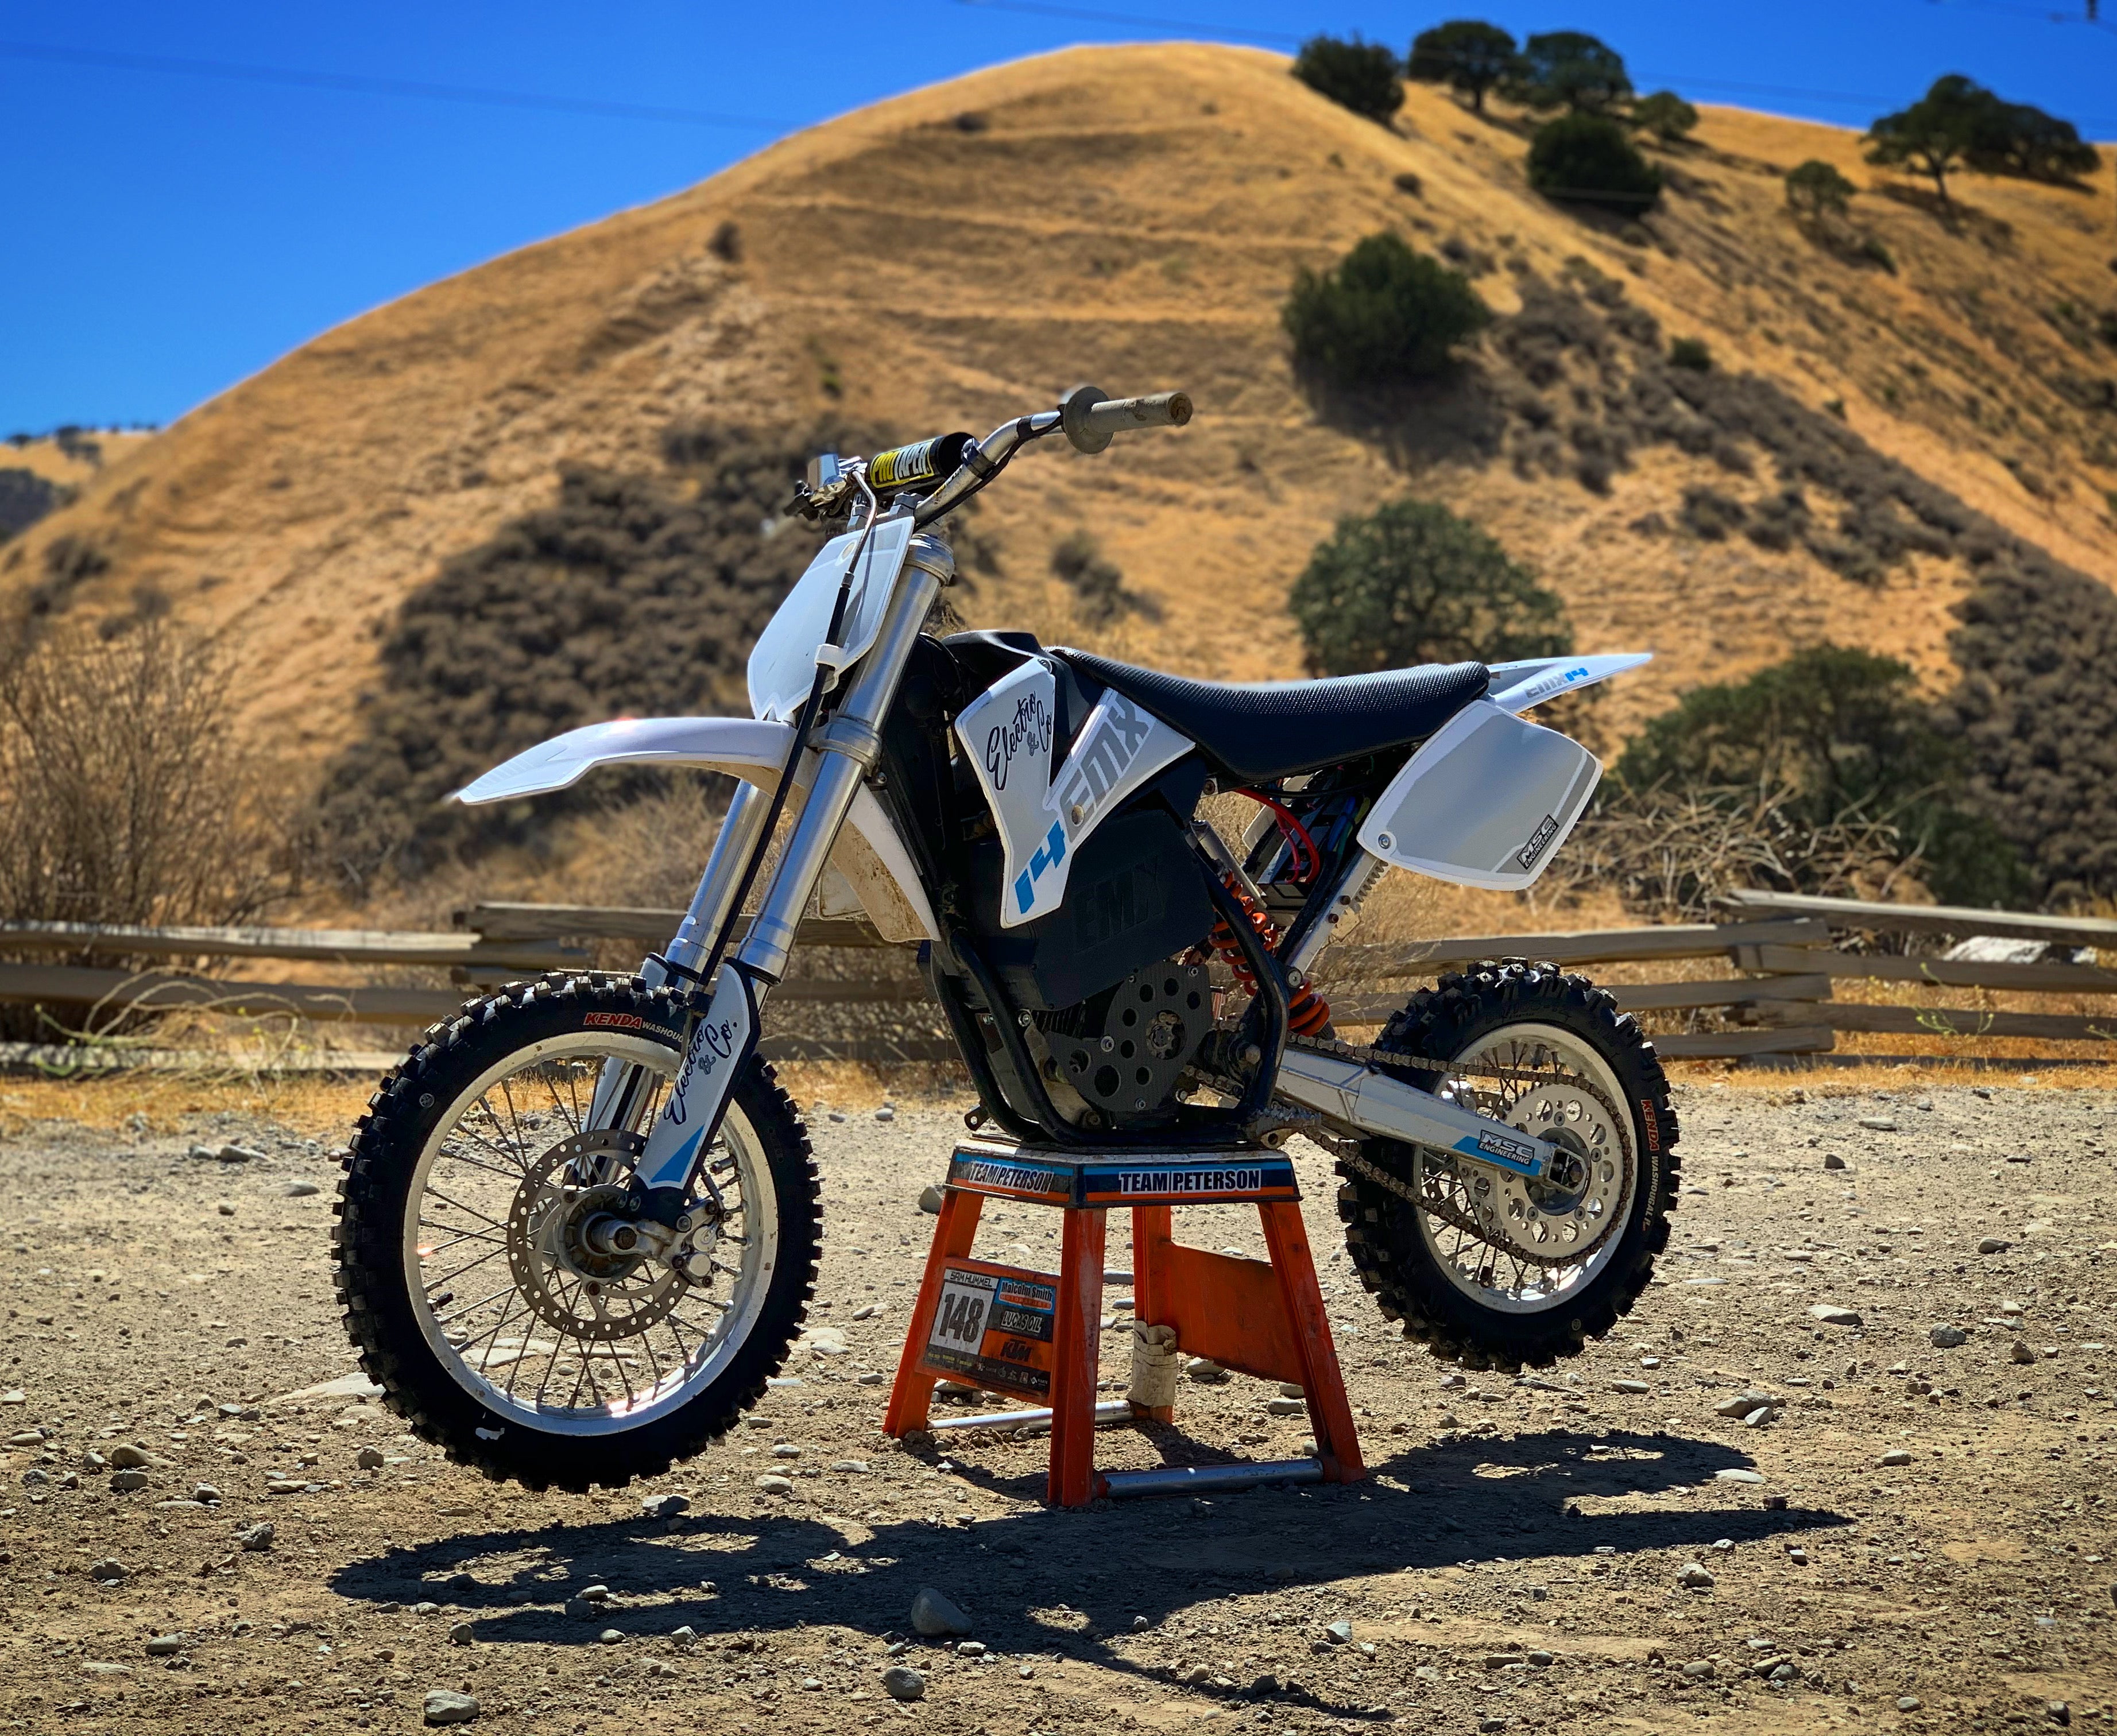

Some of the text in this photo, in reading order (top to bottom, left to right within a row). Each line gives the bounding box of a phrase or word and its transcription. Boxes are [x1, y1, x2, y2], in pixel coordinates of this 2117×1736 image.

[1522, 818, 1553, 863] MSC
[1524, 823, 1557, 867] ENGINEERING
[583, 1012, 643, 1029] KENDA
[1641, 1099, 1659, 1151] KENDA
[1479, 1142, 1530, 1165] ENGINEERING
[1481, 1133, 1533, 1158] MSC
[970, 1162, 1052, 1192] TEAM PETERSON
[1121, 1169, 1260, 1192] TEAM PETERSON
[1645, 1156, 1658, 1216] WASHOUGAL
[965, 1273, 992, 1288] HUMMEL
[1001, 1281, 1053, 1302] Malcolm Smith
[939, 1293, 984, 1343] 148
[1001, 1311, 1030, 1330] LUCAS
[1027, 1315, 1043, 1333] OIL
[1000, 1339, 1032, 1362] KTM
